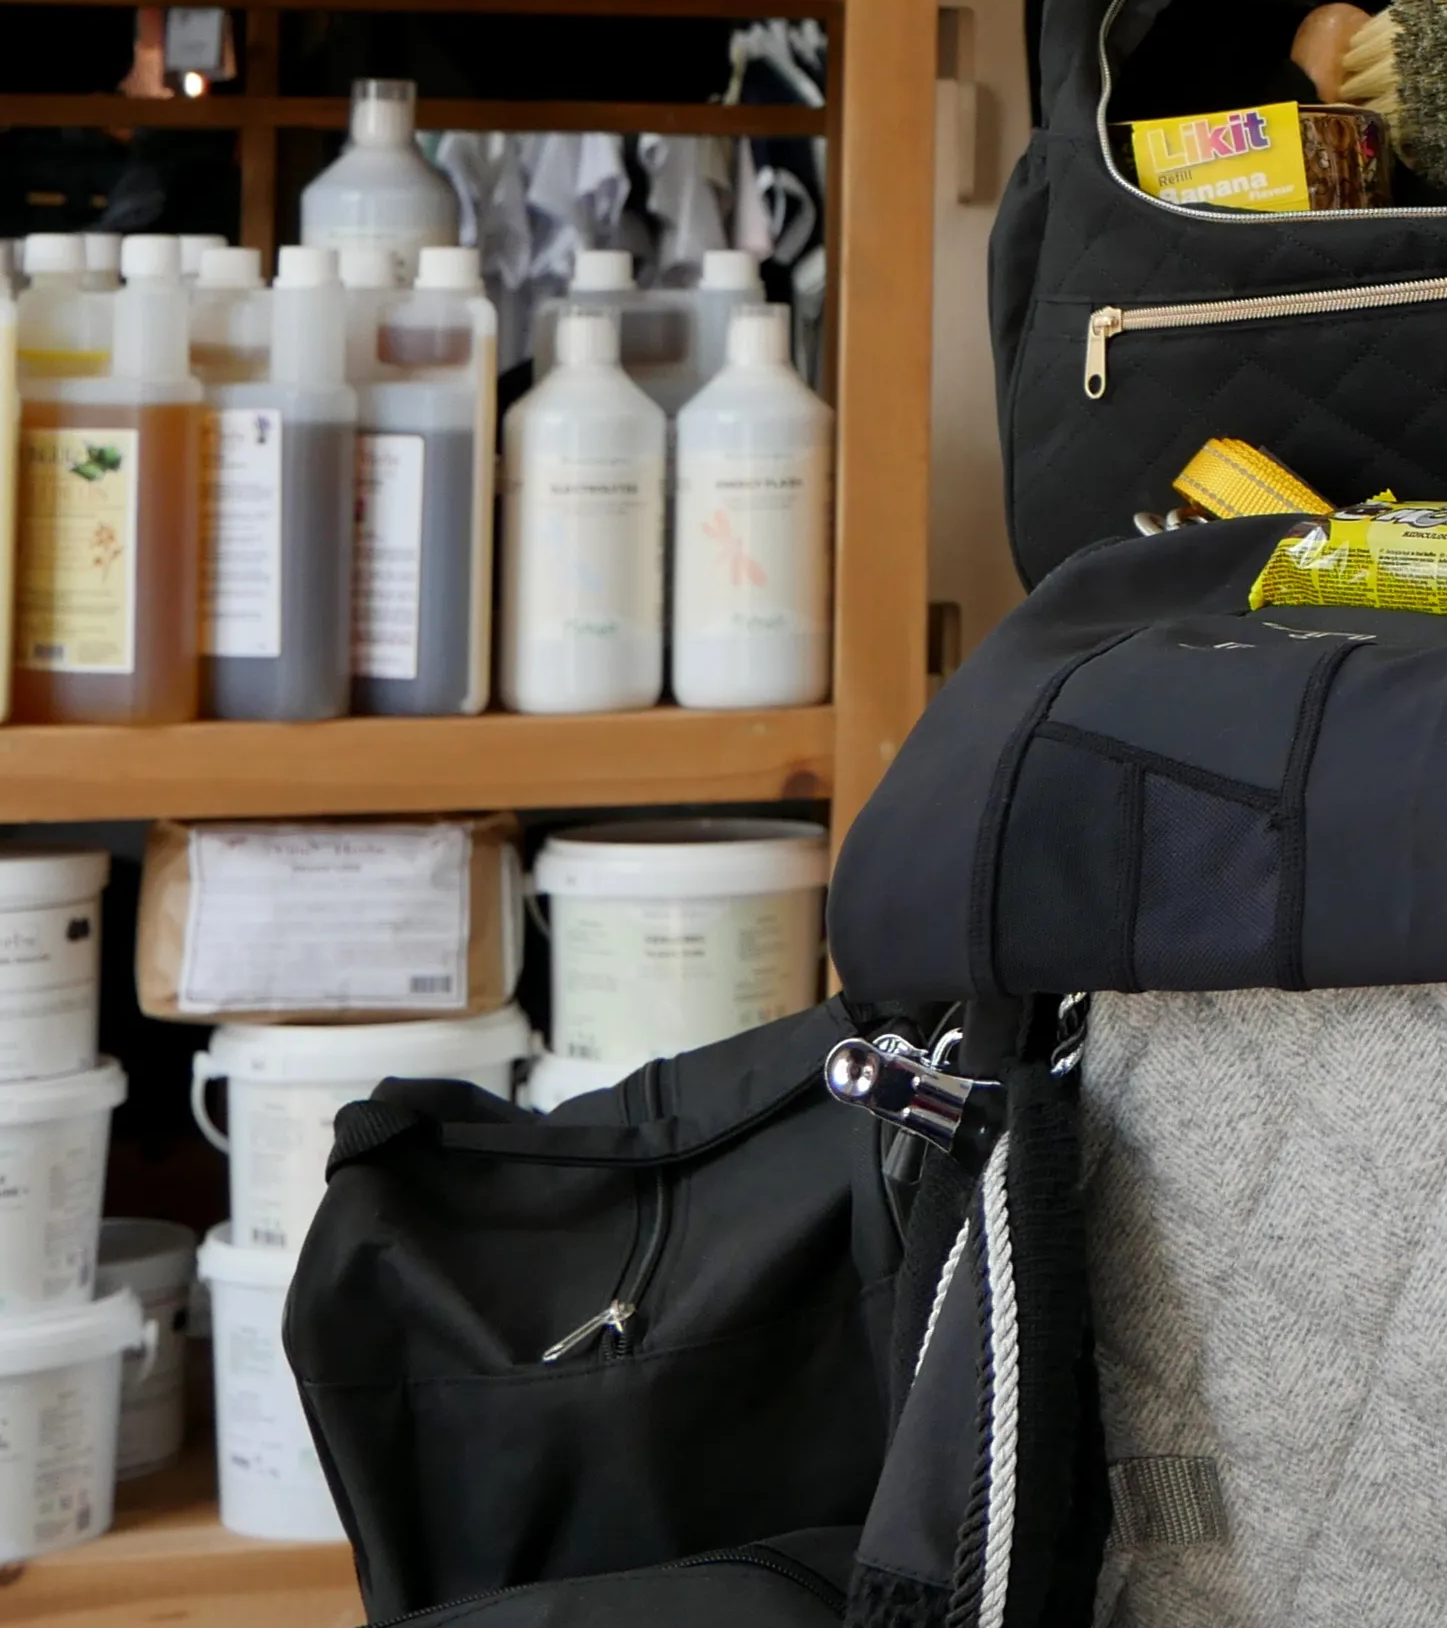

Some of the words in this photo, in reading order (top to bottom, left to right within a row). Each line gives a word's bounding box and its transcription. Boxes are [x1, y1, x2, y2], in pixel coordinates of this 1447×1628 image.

[1147, 109, 1271, 174] Likit
[1158, 170, 1193, 187] Refill
[1158, 172, 1268, 205] Banana
